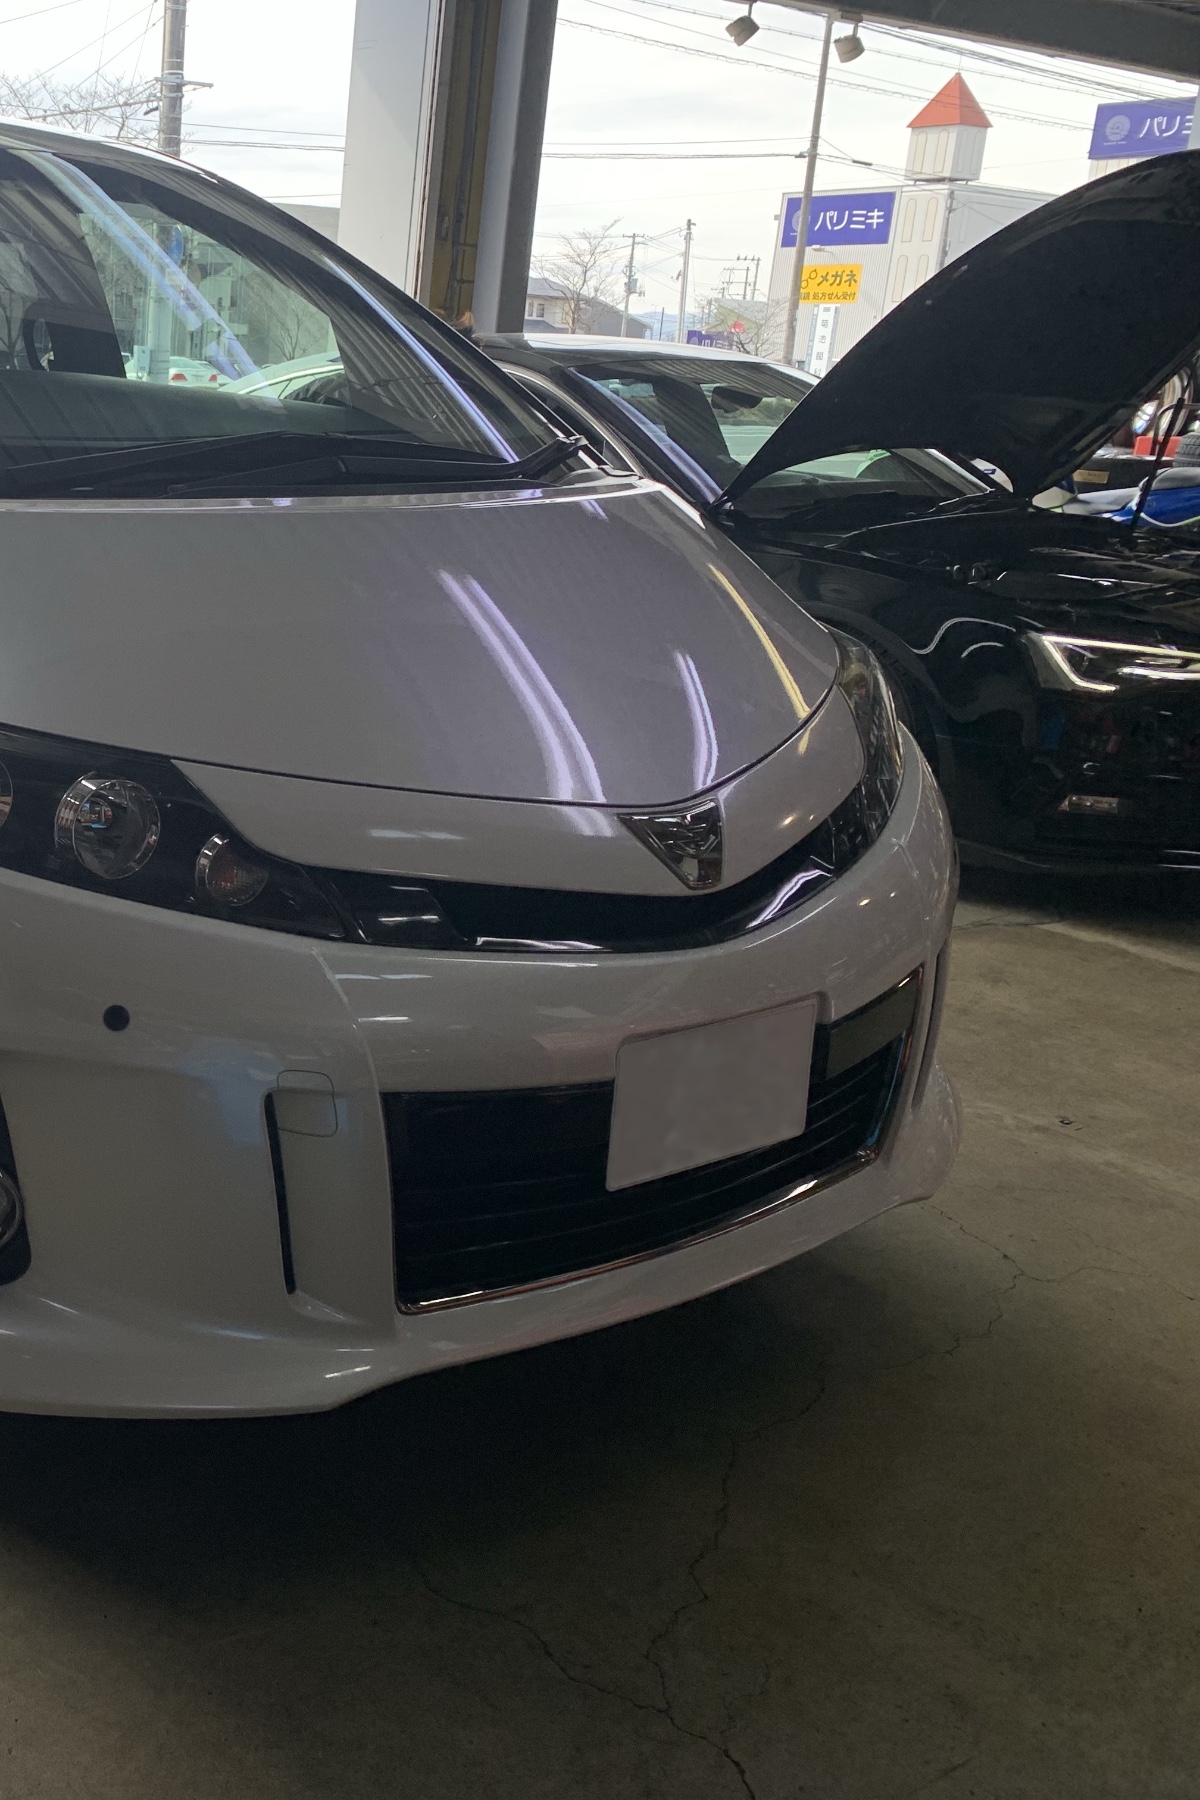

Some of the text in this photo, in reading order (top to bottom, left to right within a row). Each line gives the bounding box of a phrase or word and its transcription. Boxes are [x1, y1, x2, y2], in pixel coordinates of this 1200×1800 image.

[814, 208, 885, 231] パリミキ
[817, 269, 858, 287] メガネ
